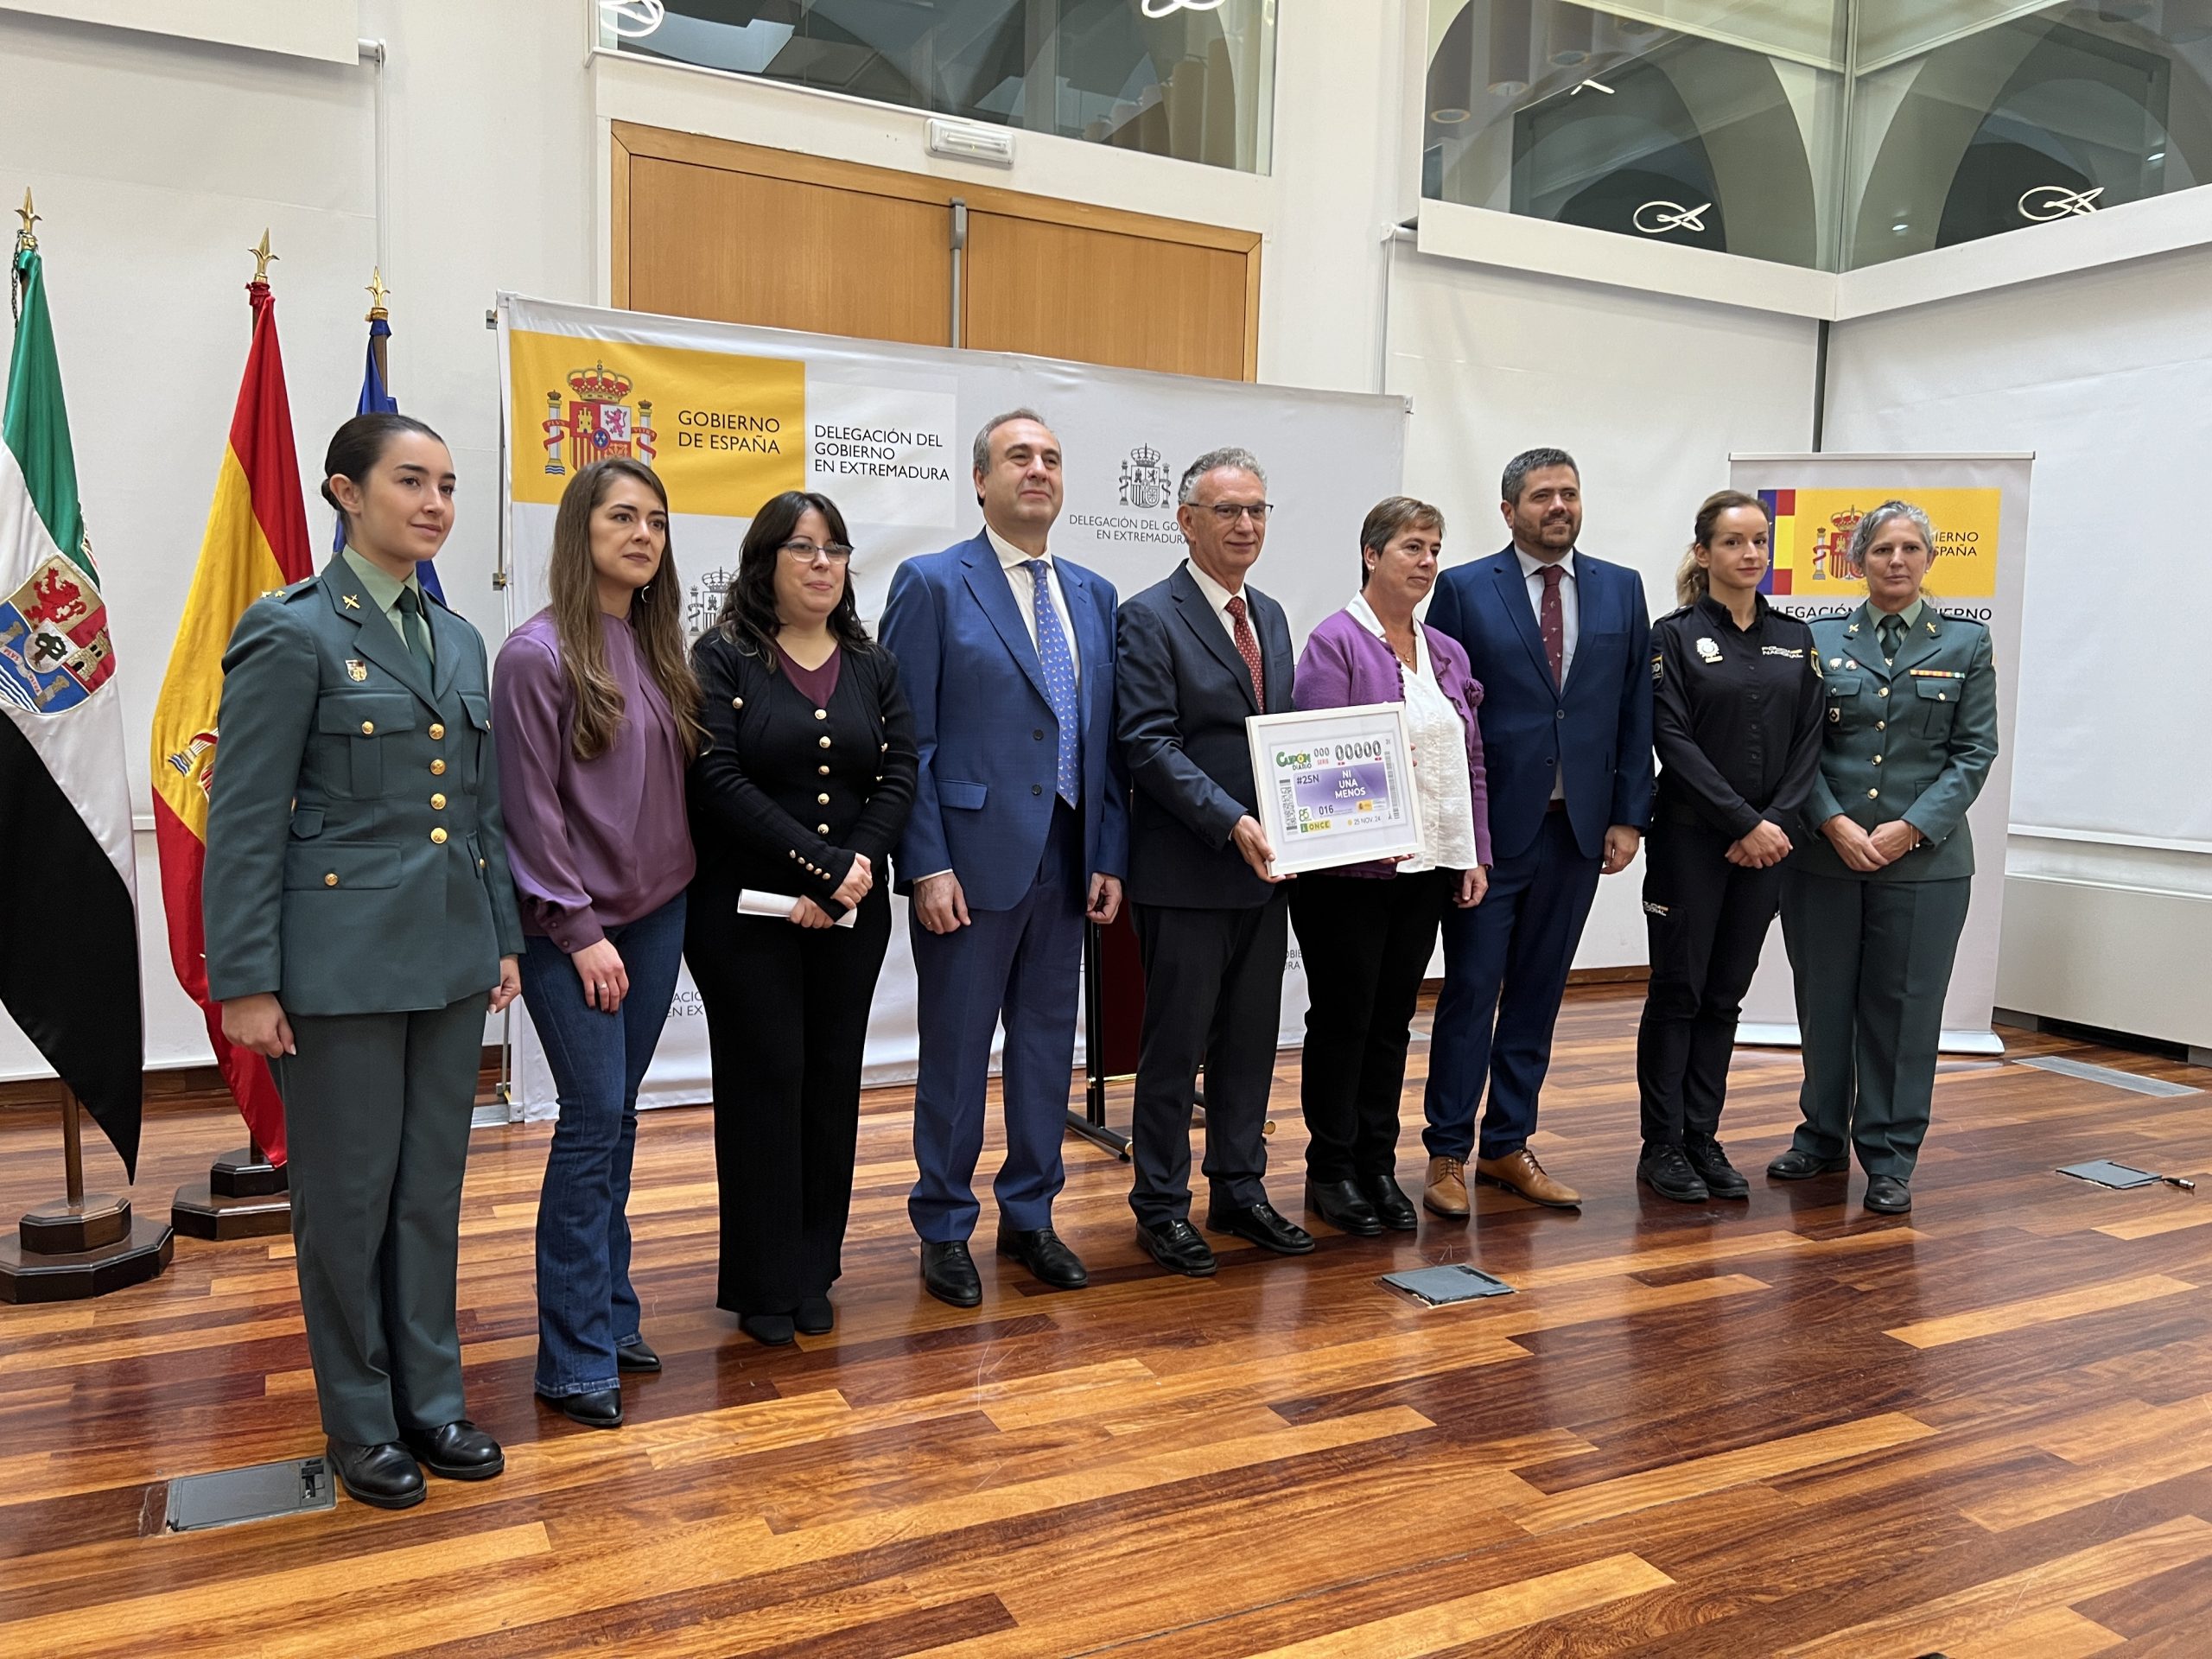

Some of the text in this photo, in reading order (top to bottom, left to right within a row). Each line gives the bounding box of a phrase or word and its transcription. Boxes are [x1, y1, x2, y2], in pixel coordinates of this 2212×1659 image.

[678, 410, 779, 433] GOBIERNO
[815, 425, 943, 447] DELEGACIÓN DEL
[679, 432, 780, 454] DE ESPAÑA
[815, 442, 895, 460] GOBIERNO
[815, 460, 950, 480] EN EXTREMADURA
[1070, 514, 1137, 529] DELEGACIÓN
[1141, 520, 1160, 531] DEL
[1096, 529, 1110, 540] EN
[1933, 543, 1977, 556] SPAÑA
[1313, 747, 1330, 758] 000
[1335, 741, 1382, 761] 00000
[1297, 774, 1319, 785] #25N
[1342, 769, 1351, 779] NI
[1338, 779, 1358, 789] UNA
[1335, 787, 1366, 799] MENOS
[1299, 808, 1309, 822] 85
[1319, 804, 1334, 815] 016
[1309, 821, 1330, 830] ONCE
